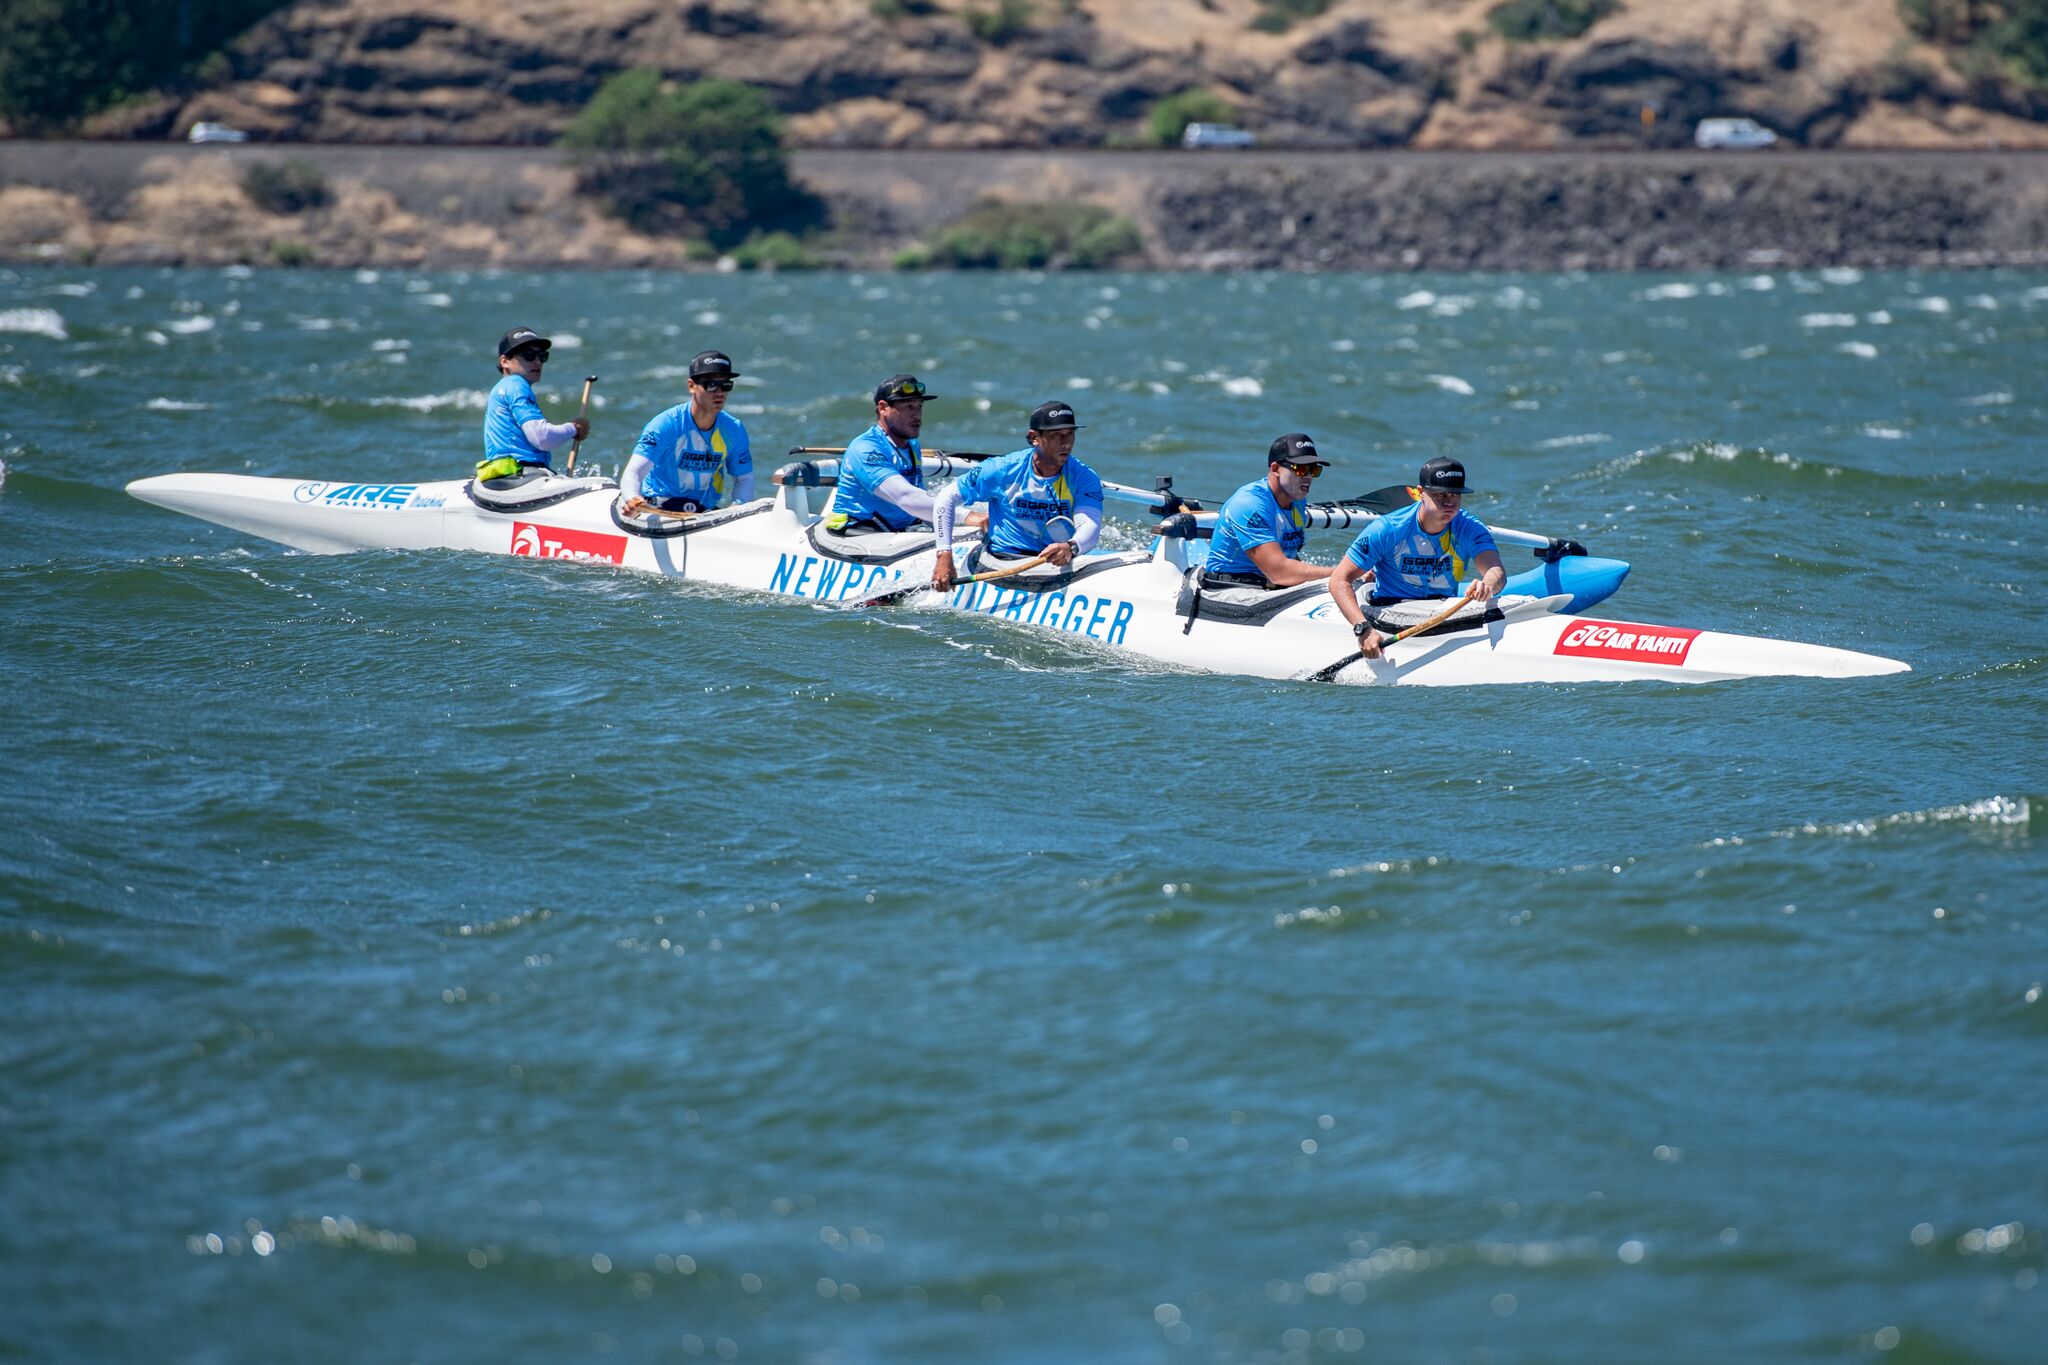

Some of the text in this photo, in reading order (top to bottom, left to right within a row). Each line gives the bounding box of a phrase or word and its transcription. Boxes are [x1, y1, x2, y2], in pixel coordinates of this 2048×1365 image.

[683, 452, 721, 462] GORE
[325, 485, 418, 504] ARE
[326, 500, 401, 511] TAHITI
[769, 553, 905, 601] NEWPO
[1604, 632, 1689, 654] AIR TAHITI
